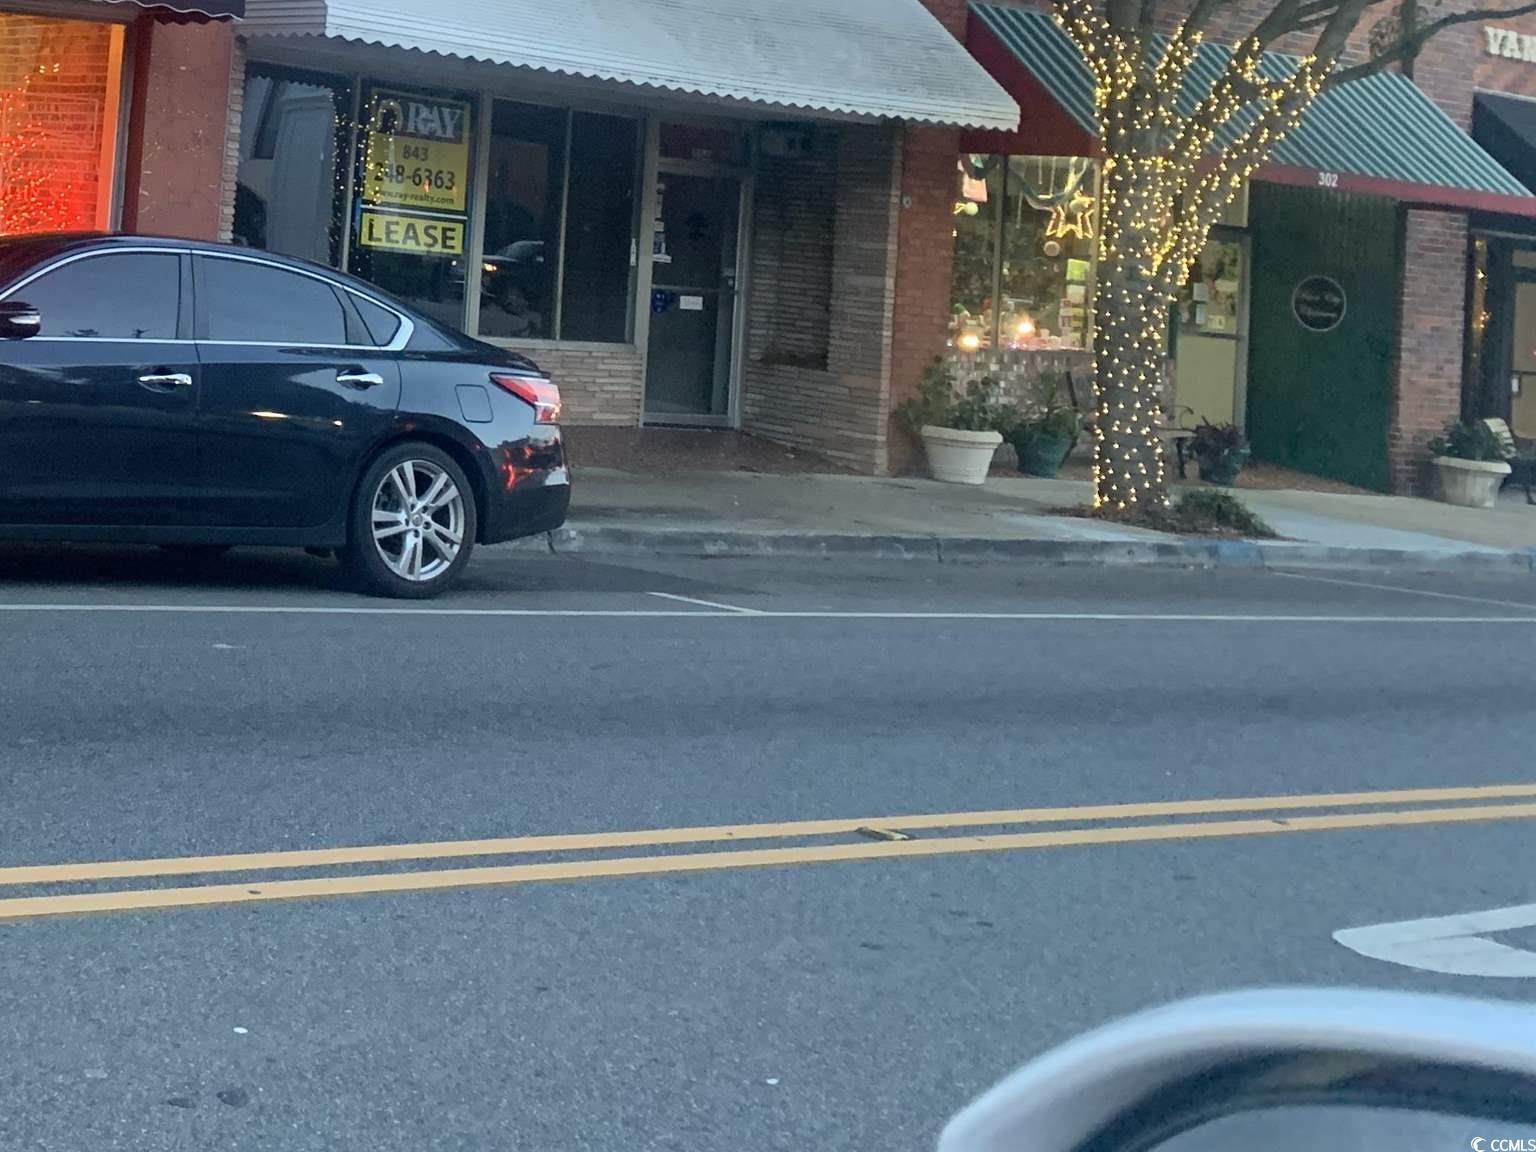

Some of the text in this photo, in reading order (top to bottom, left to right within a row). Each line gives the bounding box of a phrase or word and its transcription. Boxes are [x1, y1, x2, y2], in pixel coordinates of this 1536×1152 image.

[402, 144, 429, 162] 843
[373, 161, 456, 190] 248-6363
[1317, 171, 1339, 188] 302
[367, 219, 456, 250] LEASE
